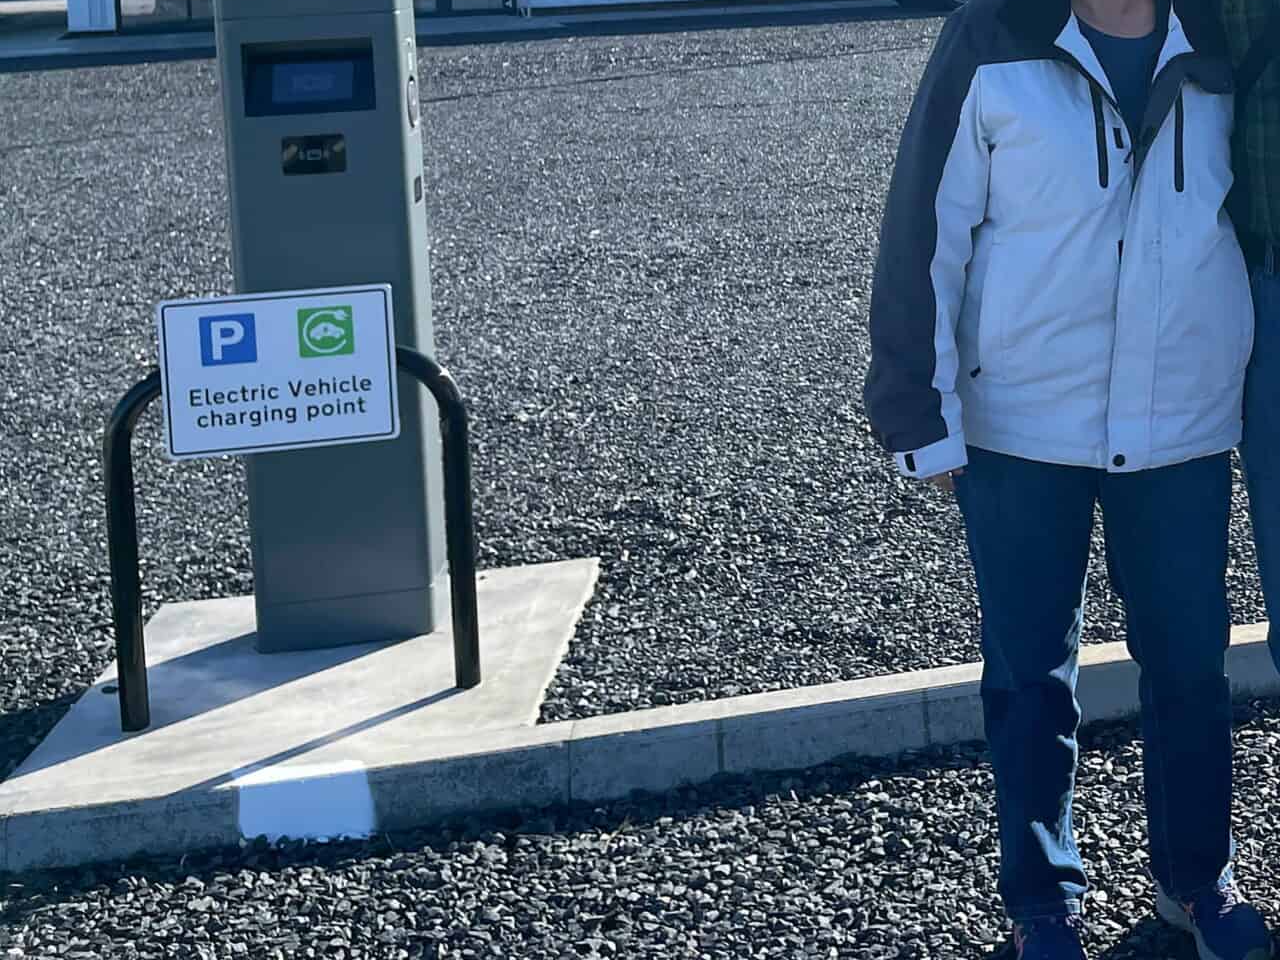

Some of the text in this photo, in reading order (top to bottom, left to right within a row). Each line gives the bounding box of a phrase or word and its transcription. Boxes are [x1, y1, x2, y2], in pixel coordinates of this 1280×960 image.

[210, 320, 244, 361] P
[189, 376, 373, 407] Electric Vehicle
[196, 396, 367, 428] charging point
